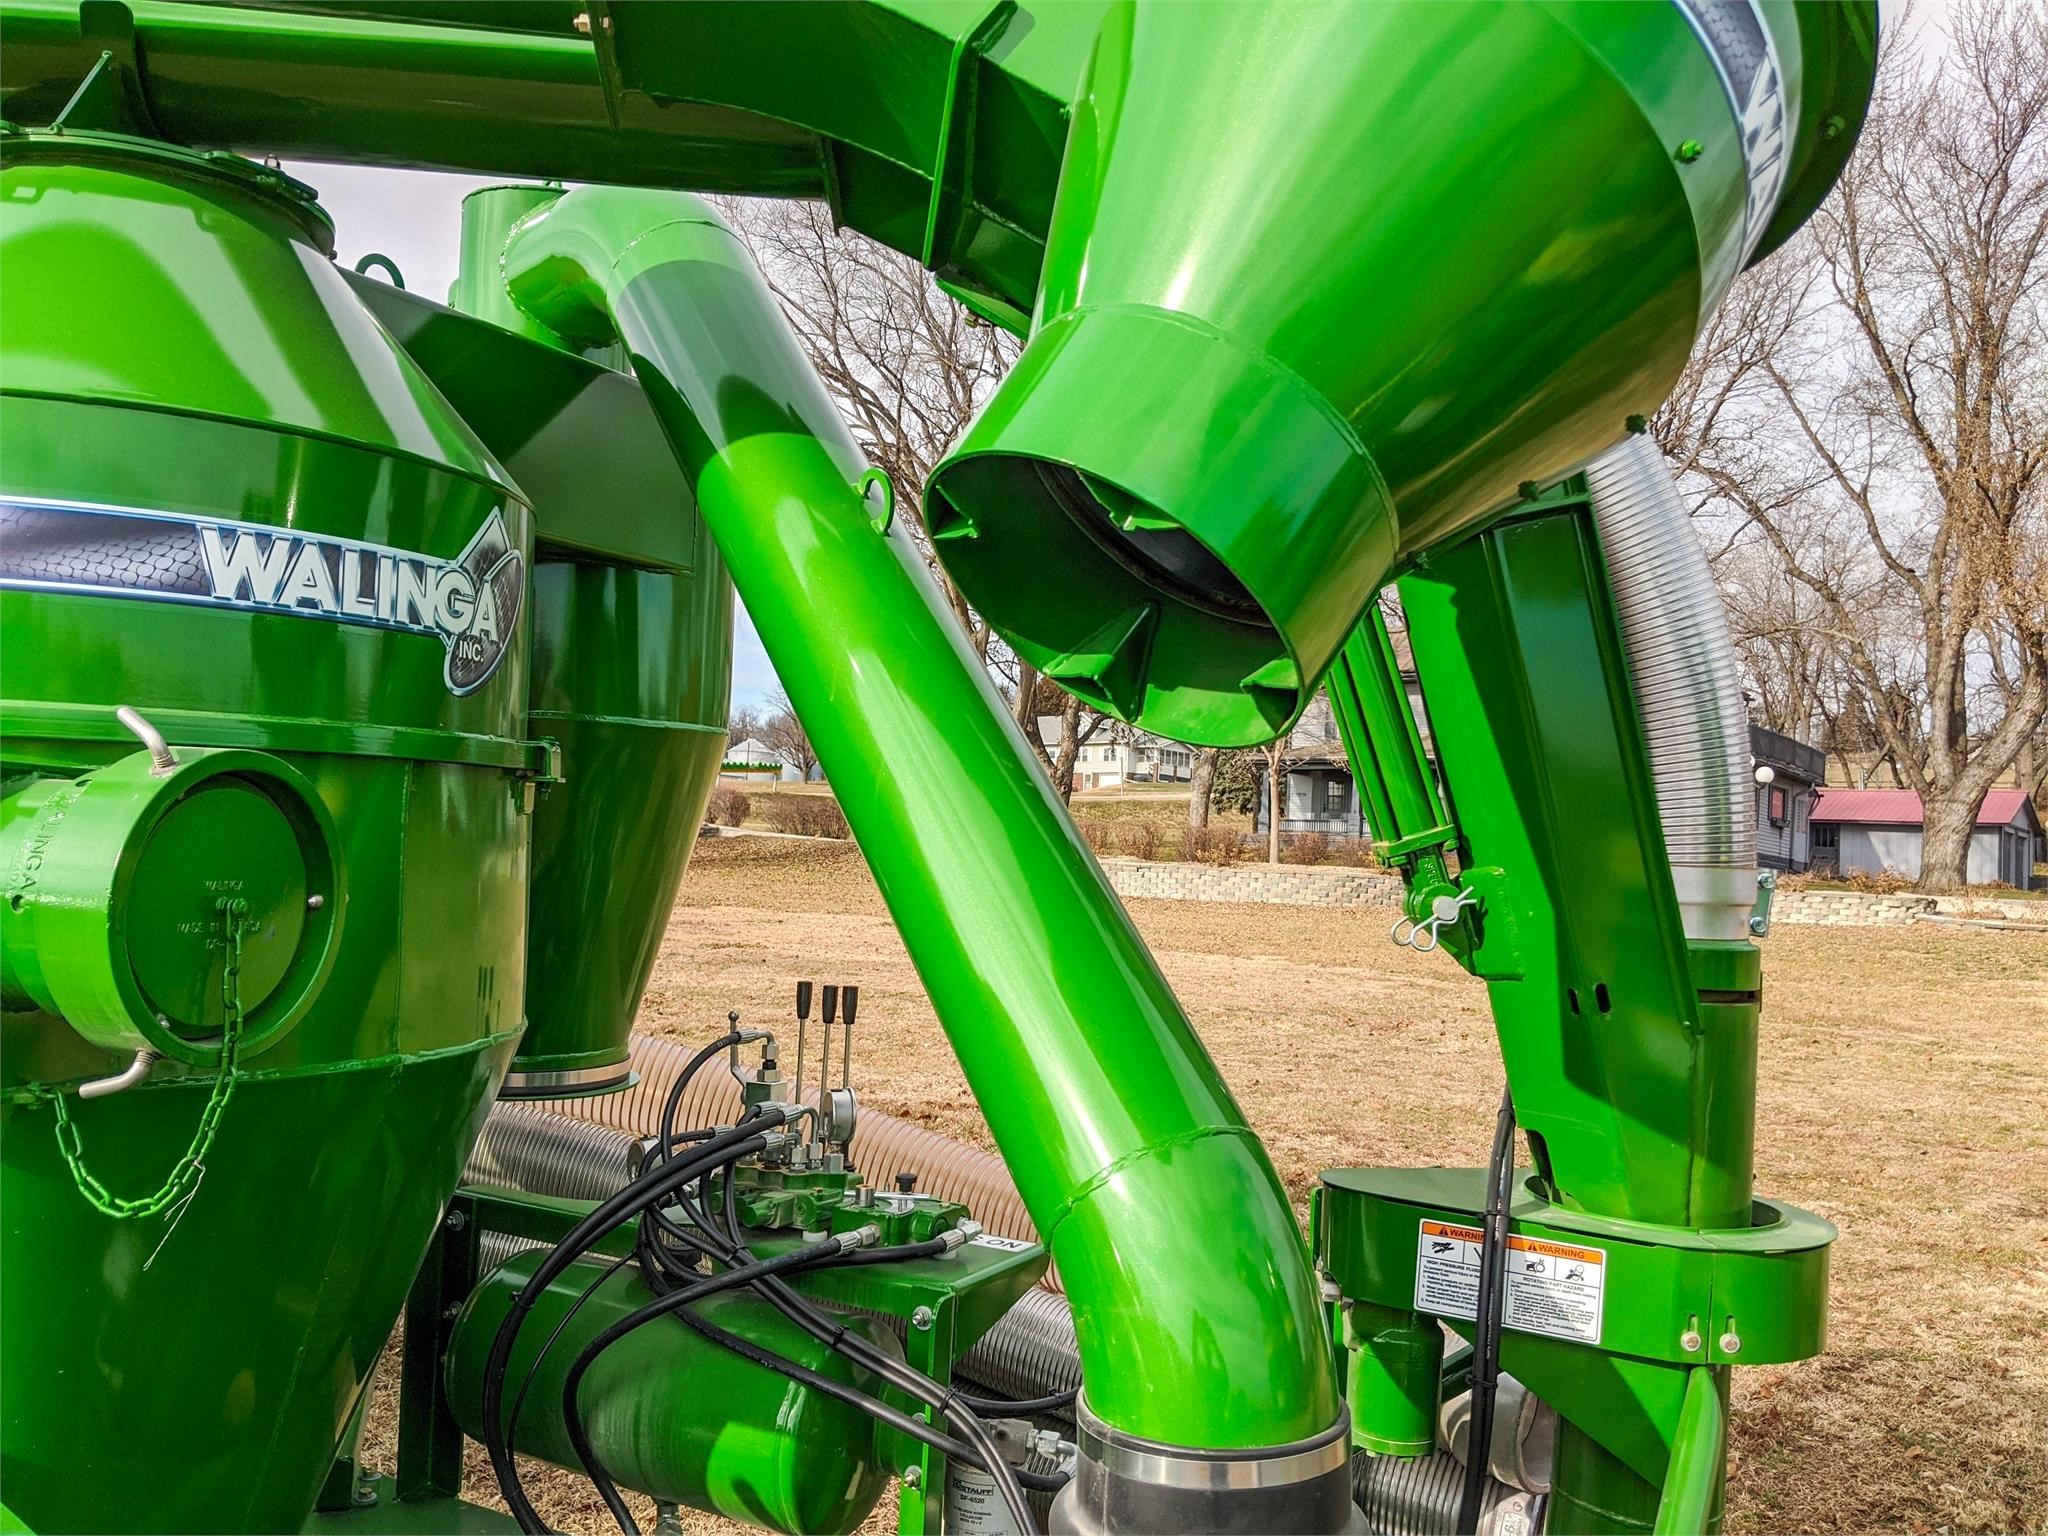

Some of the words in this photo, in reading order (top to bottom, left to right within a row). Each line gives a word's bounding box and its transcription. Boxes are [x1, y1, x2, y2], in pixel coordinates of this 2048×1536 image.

[197, 524, 500, 643] WALINGA
[459, 640, 485, 663] INC.
[1449, 1228, 1486, 1241] WARNIN
[1539, 1244, 1585, 1259] WARNING
